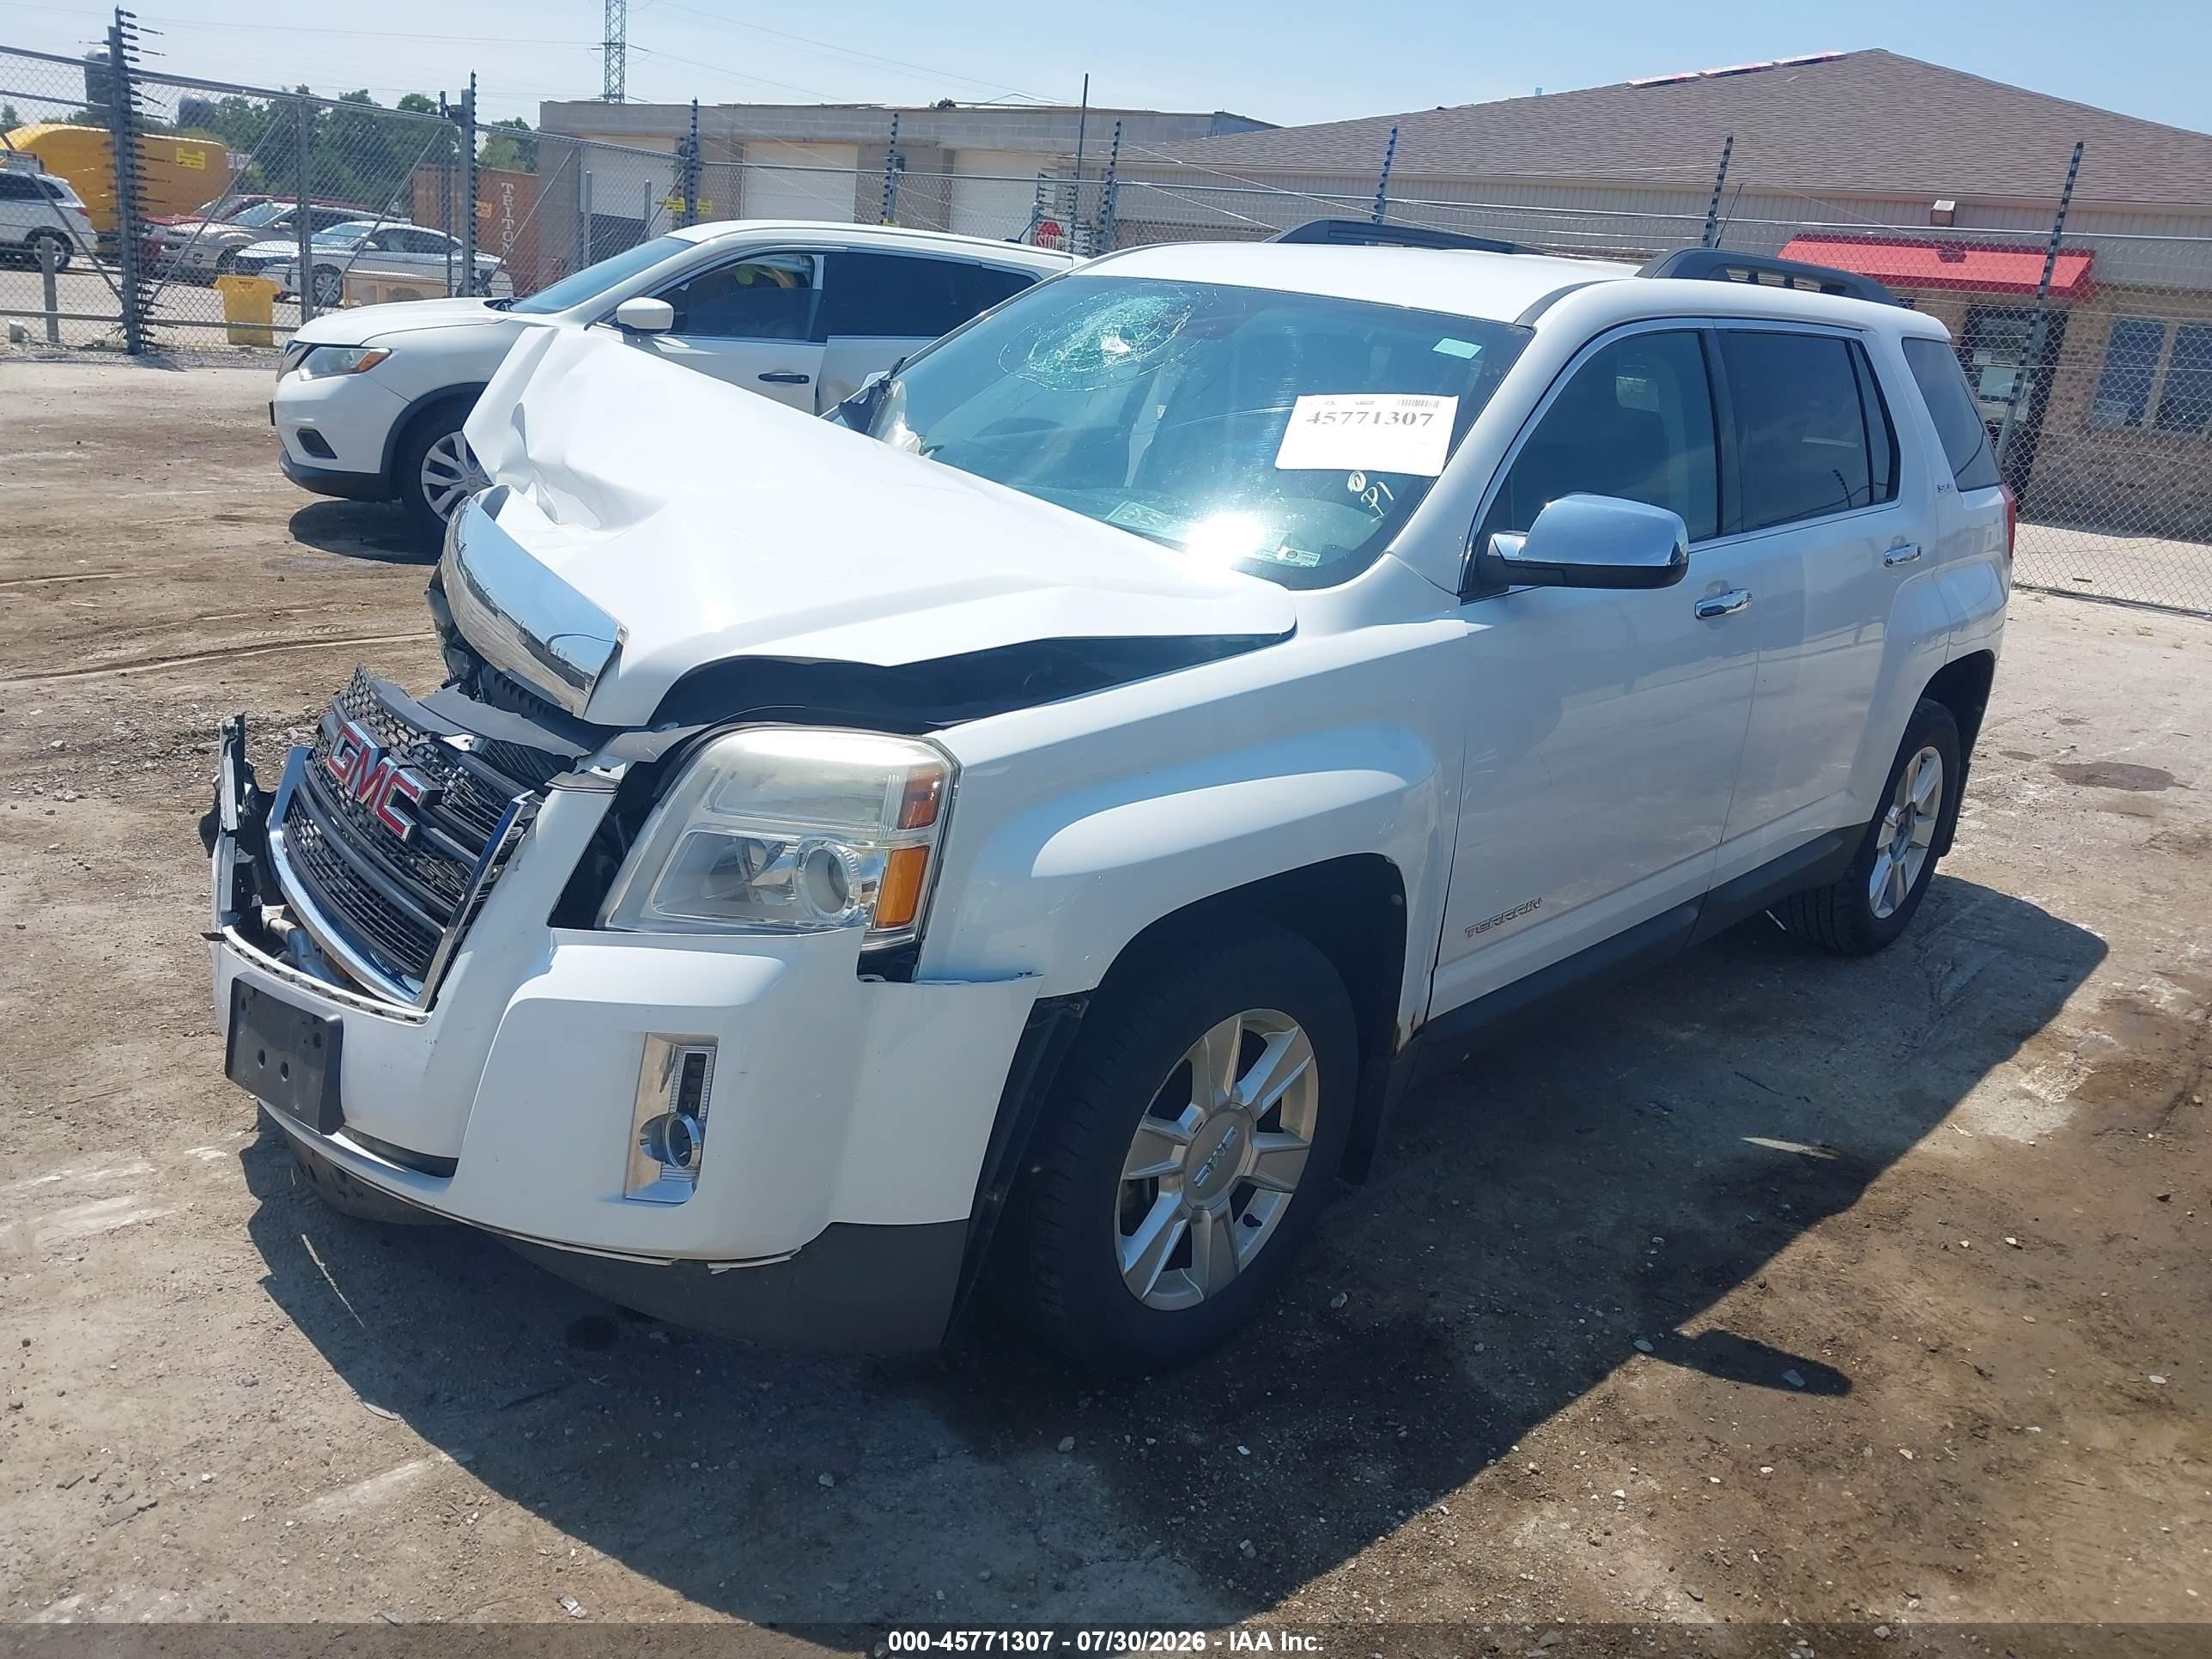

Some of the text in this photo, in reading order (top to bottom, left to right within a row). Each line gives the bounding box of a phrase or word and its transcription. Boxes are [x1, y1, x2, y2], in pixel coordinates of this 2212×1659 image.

[1305, 410, 1435, 428] 45771307
[327, 721, 428, 842] GMC
[1465, 896, 1543, 939] TERRAIN
